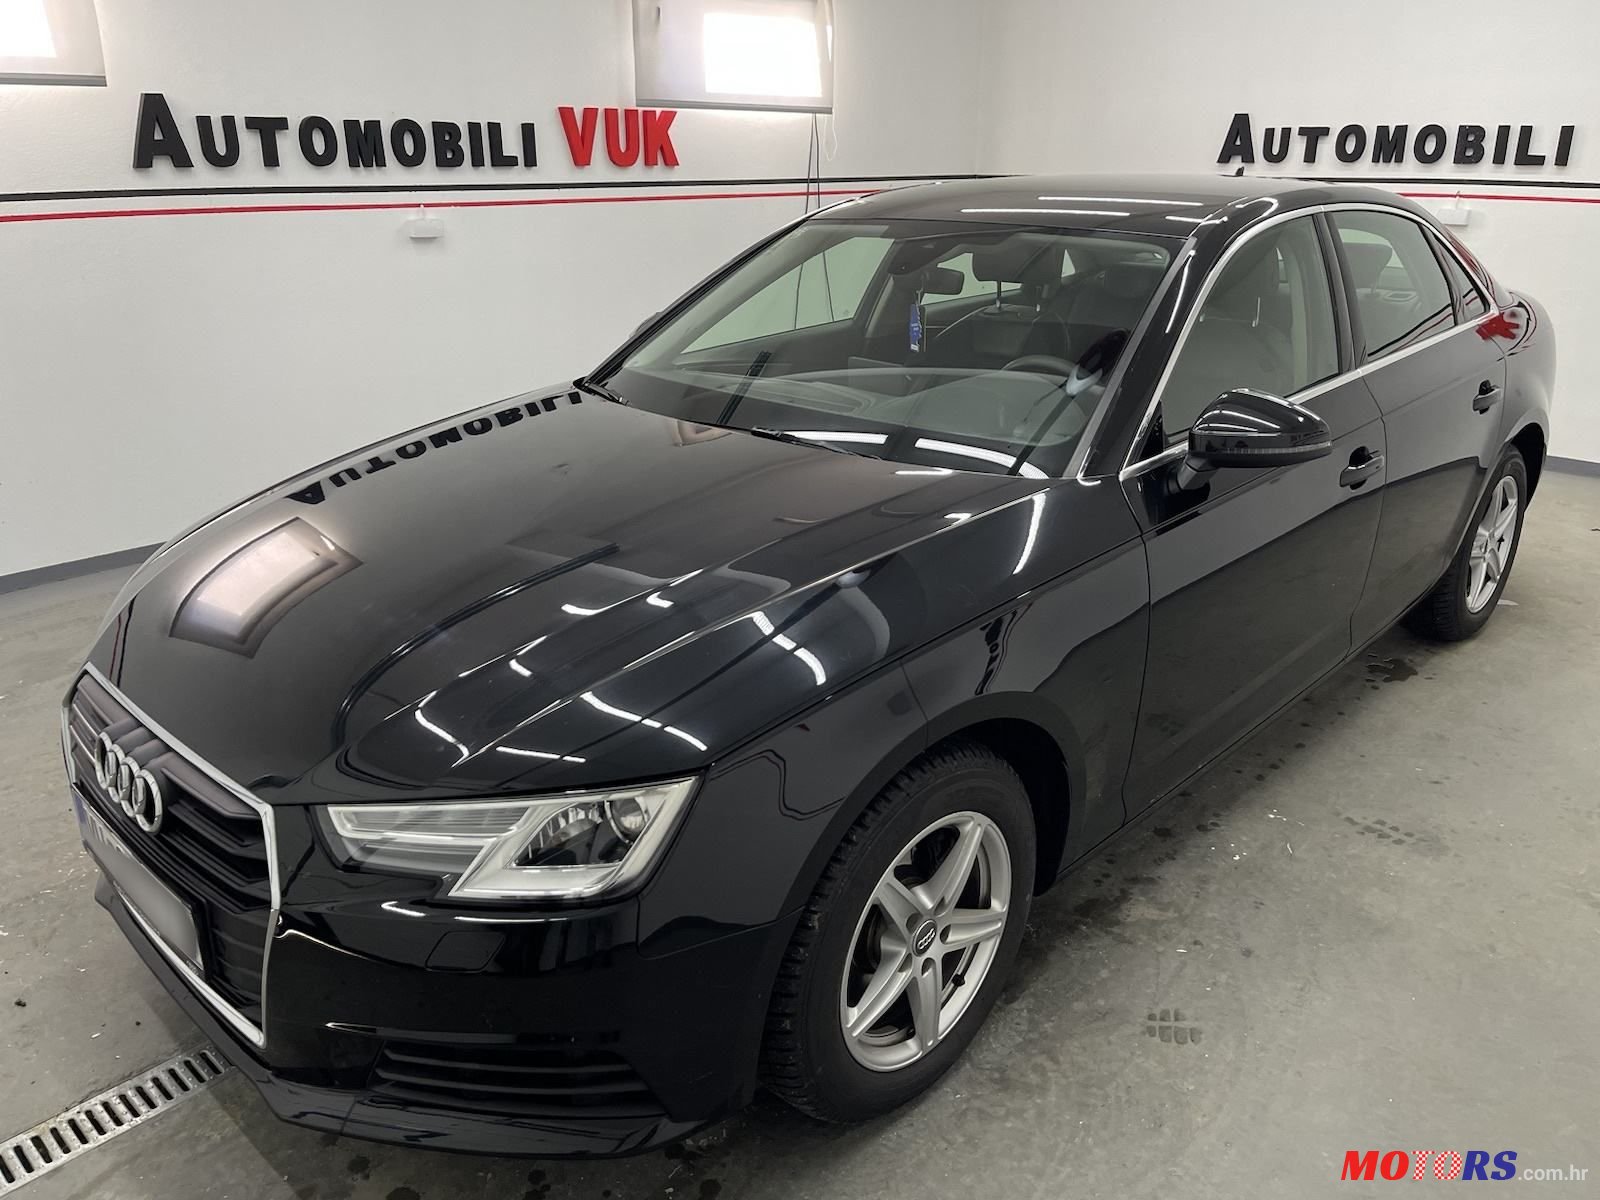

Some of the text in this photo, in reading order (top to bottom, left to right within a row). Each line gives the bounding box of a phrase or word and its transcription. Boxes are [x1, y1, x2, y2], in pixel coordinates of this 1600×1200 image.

[133, 92, 679, 169] AUTOMOBILI VUK
[1217, 113, 1575, 167] AUTOMOBILI
